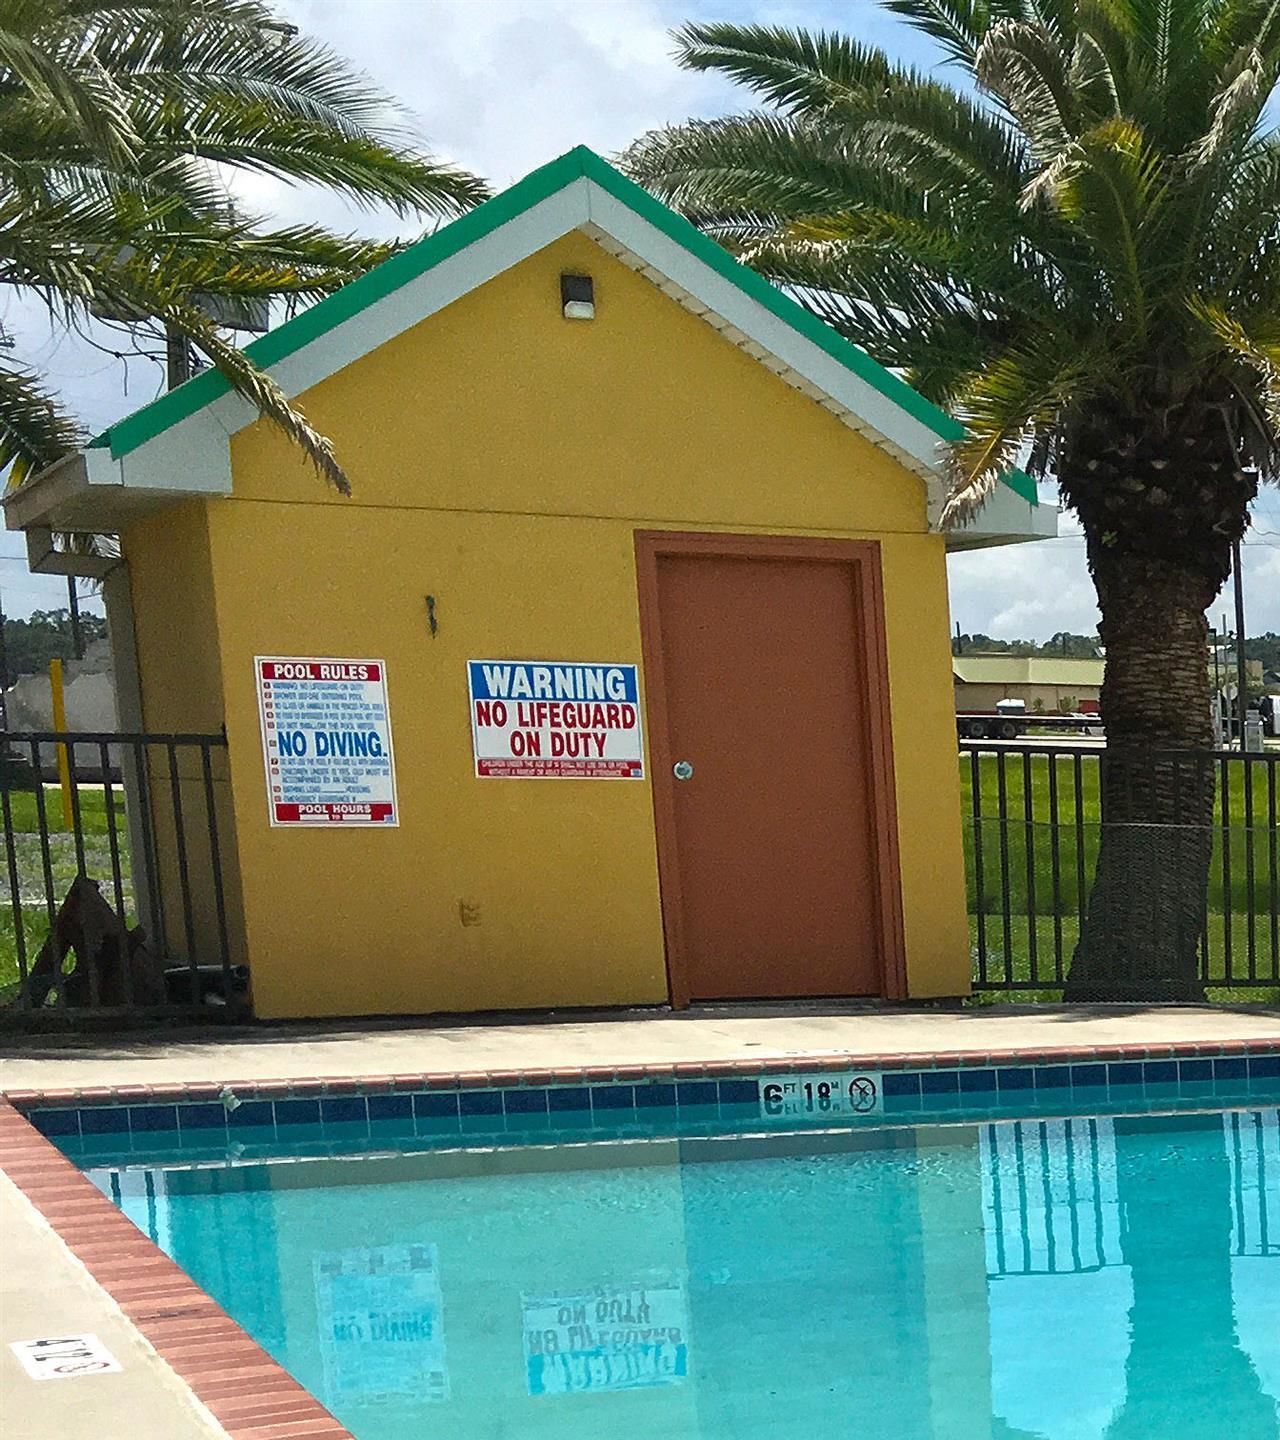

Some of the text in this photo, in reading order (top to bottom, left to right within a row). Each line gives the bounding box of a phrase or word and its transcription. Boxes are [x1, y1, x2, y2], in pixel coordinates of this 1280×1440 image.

[274, 664, 369, 680] POOL RULES
[482, 665, 627, 700] WARNING
[476, 701, 636, 729] NO LIFEGUARD
[278, 731, 388, 757] NO DIVING.
[510, 731, 607, 758] ON DUTY
[299, 805, 372, 813] POOL HOURS
